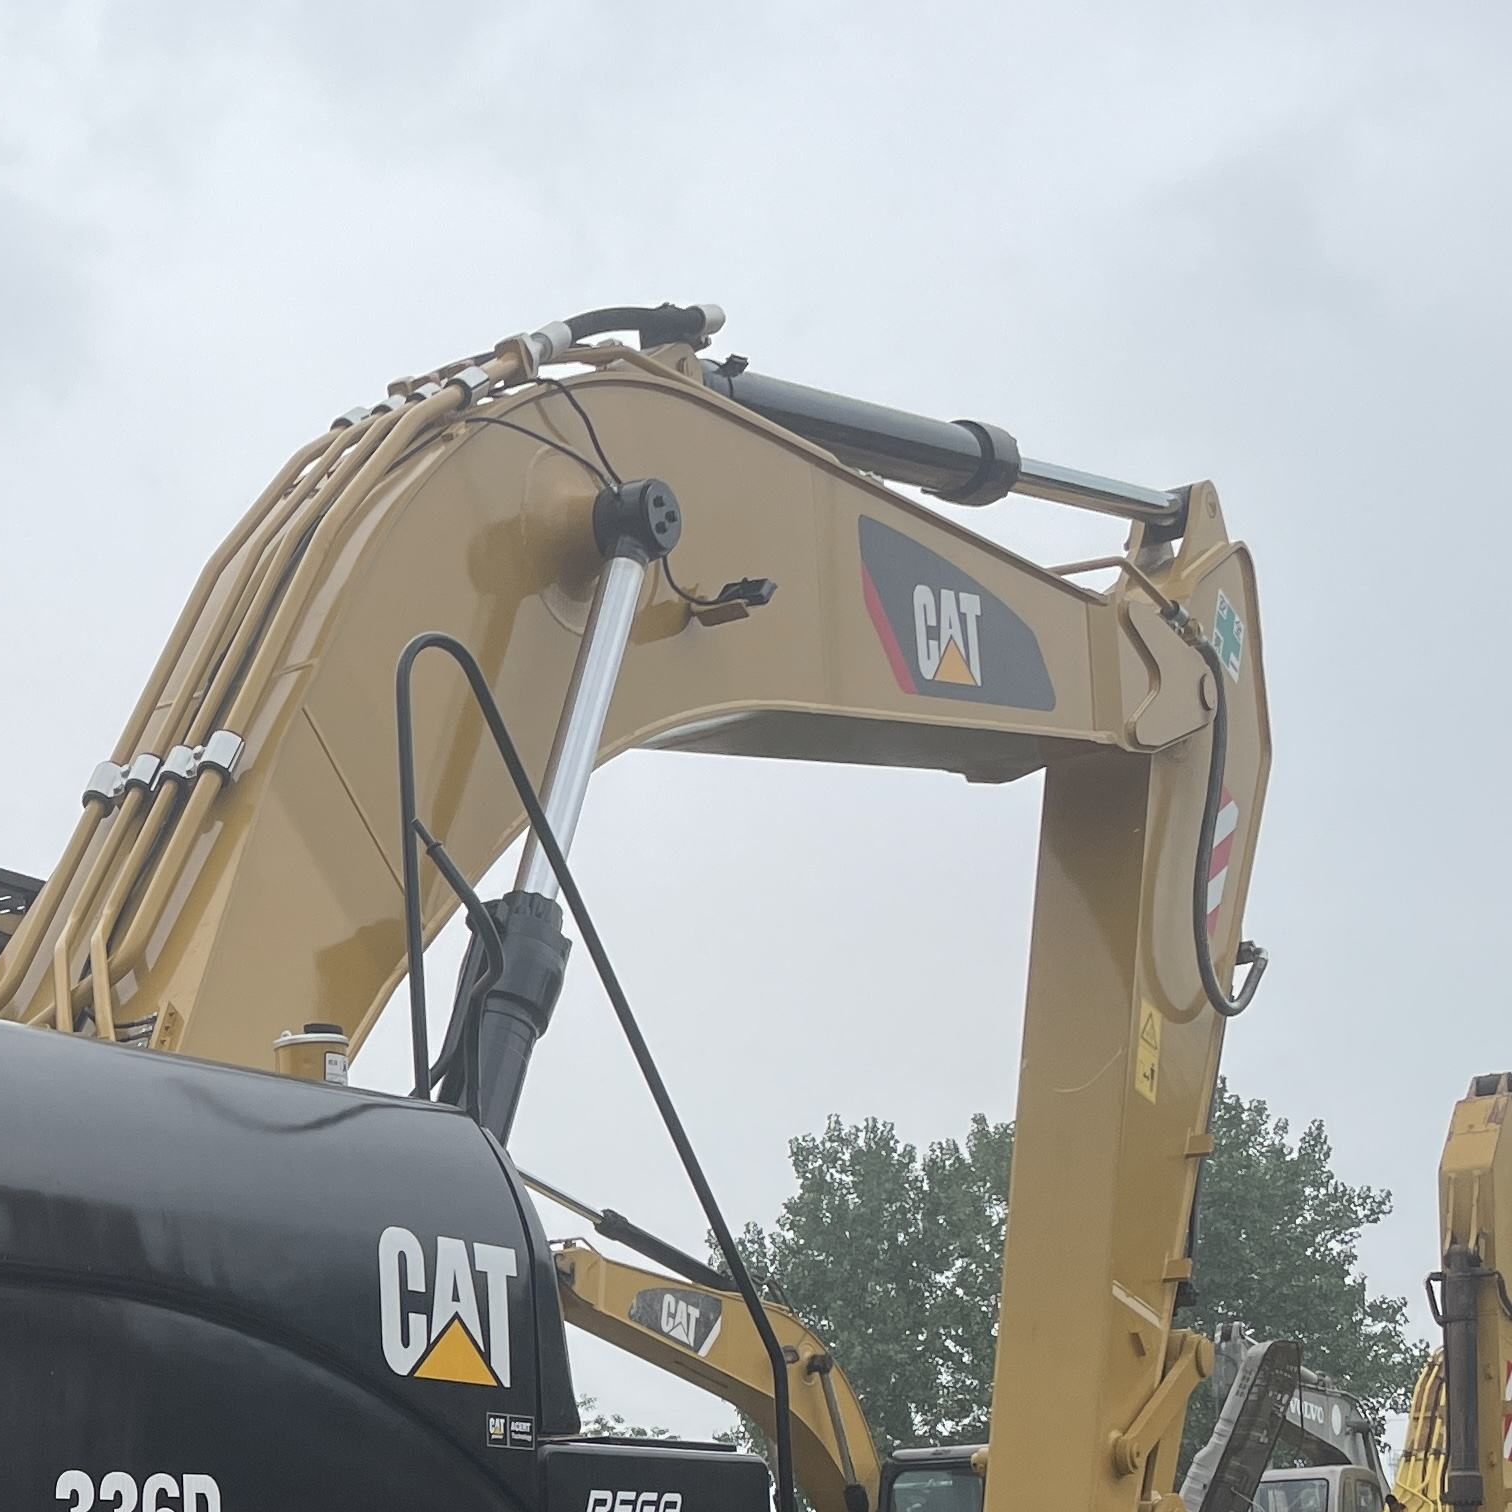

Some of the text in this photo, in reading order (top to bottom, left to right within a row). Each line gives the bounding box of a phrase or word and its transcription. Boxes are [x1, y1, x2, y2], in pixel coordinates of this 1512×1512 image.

[913, 584, 981, 686] CAT
[378, 1226, 518, 1388] CAT
[661, 1294, 700, 1347] CAT
[489, 1417, 505, 1434] CAT
